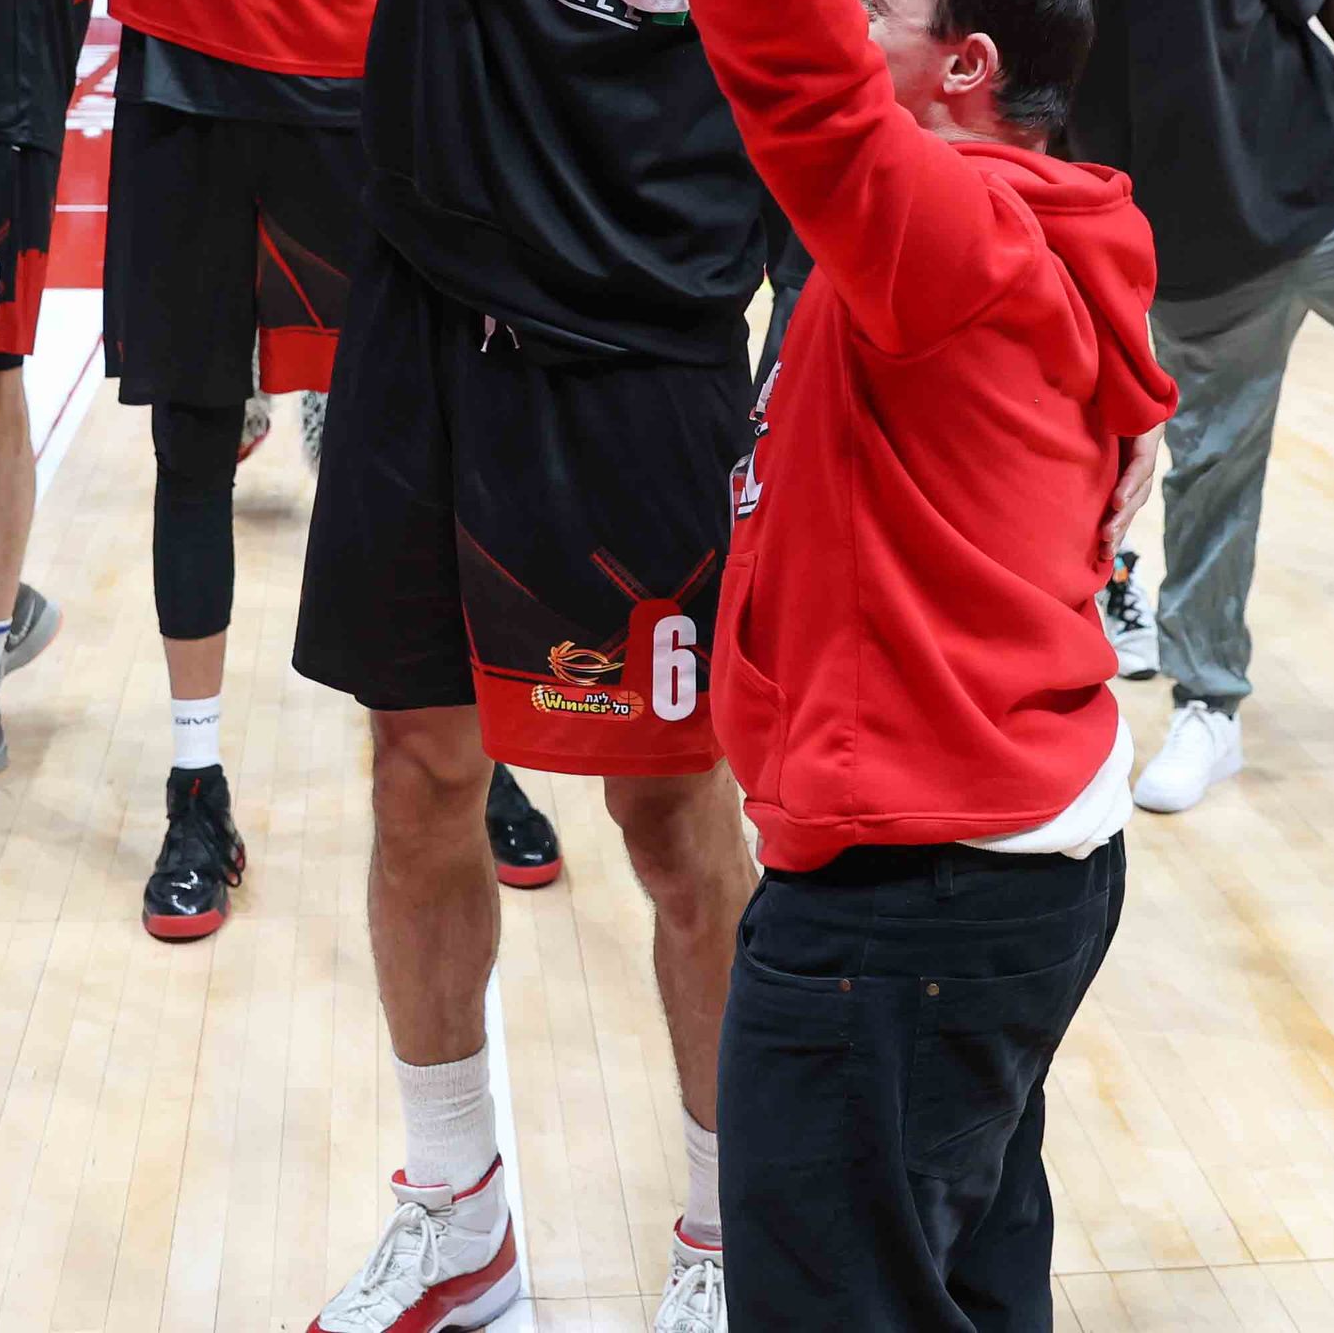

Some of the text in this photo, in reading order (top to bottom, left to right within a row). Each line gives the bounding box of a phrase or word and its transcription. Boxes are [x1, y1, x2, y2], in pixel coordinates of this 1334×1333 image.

[651, 614, 698, 722] 6
[543, 691, 629, 714] Winner סל
[586, 692, 609, 704] ליגת
